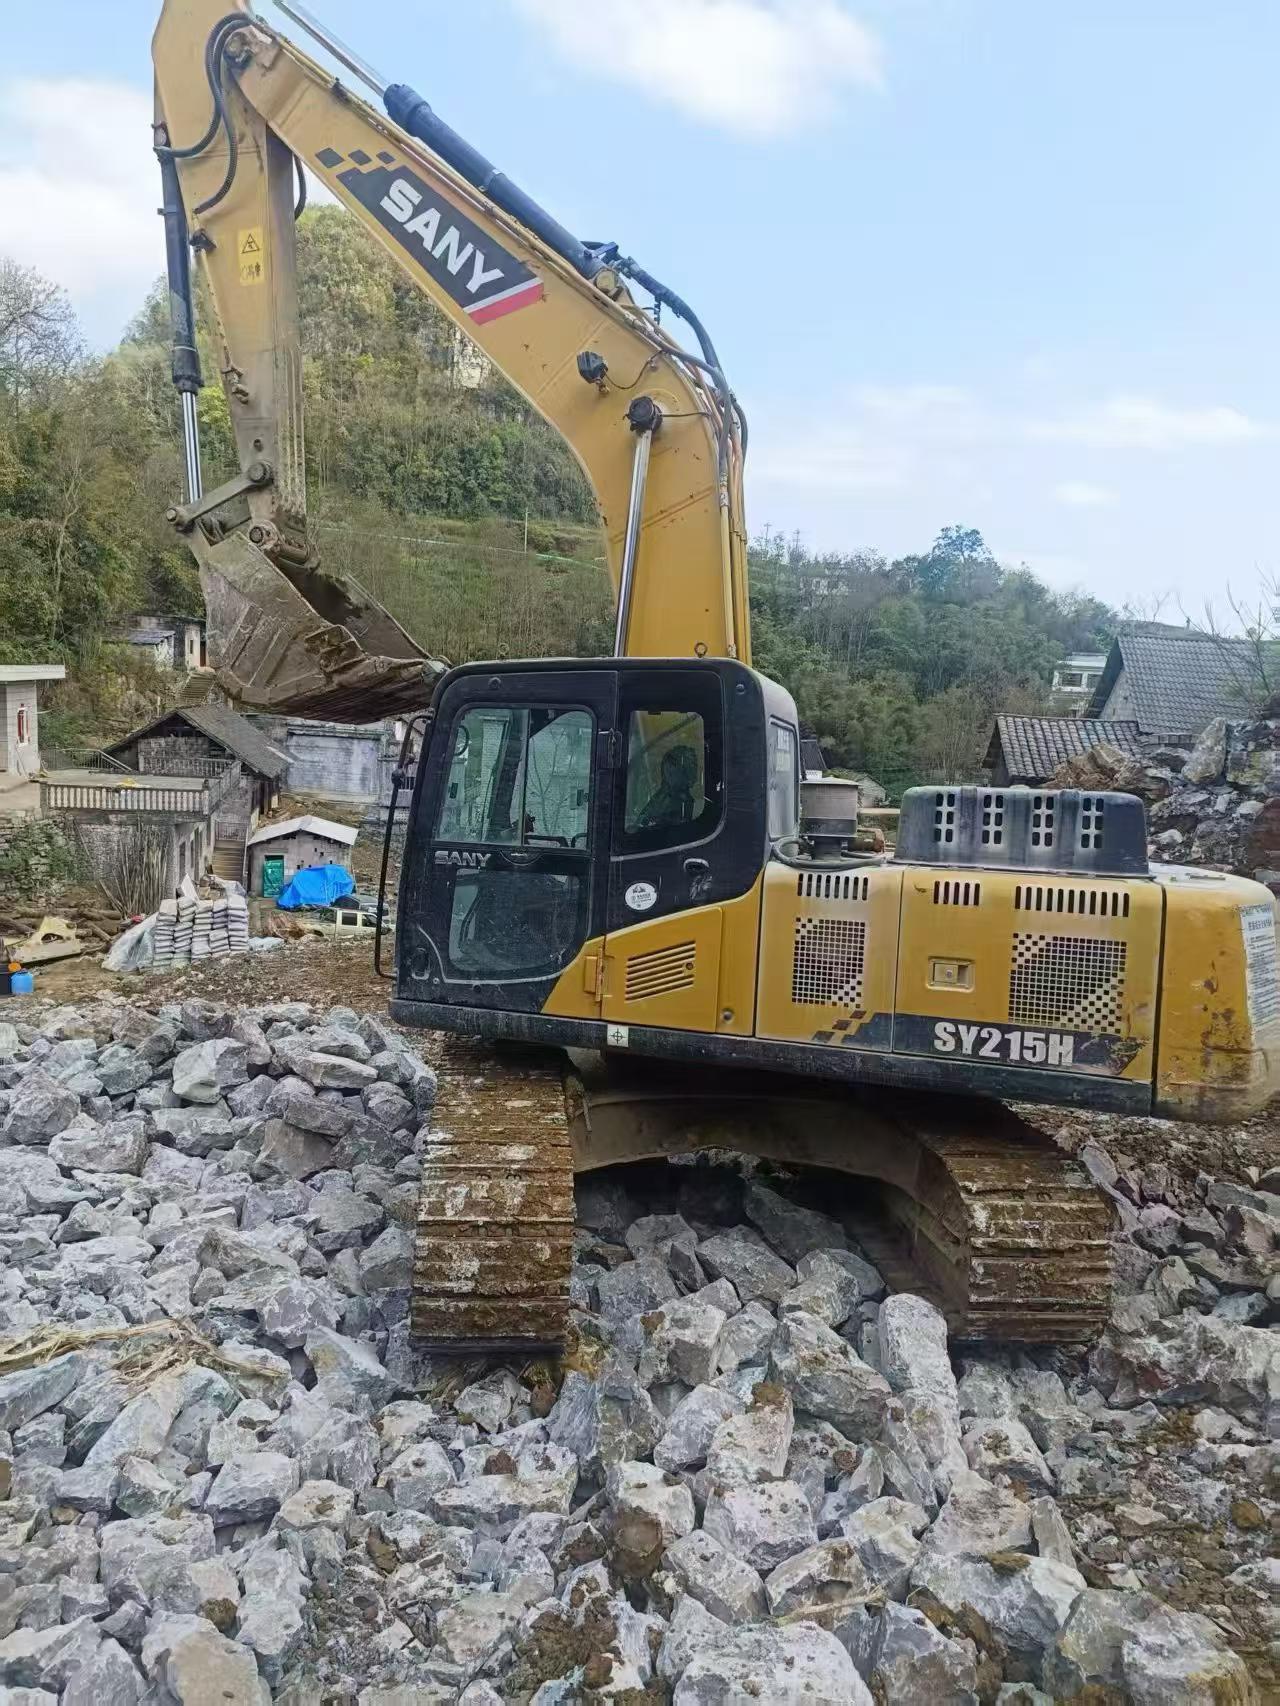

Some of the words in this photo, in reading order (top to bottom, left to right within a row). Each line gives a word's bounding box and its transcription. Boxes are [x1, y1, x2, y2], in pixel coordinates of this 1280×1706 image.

[379, 178, 505, 294] SANY
[434, 850, 491, 867] SANY
[933, 1021, 1074, 1066] SY215H
